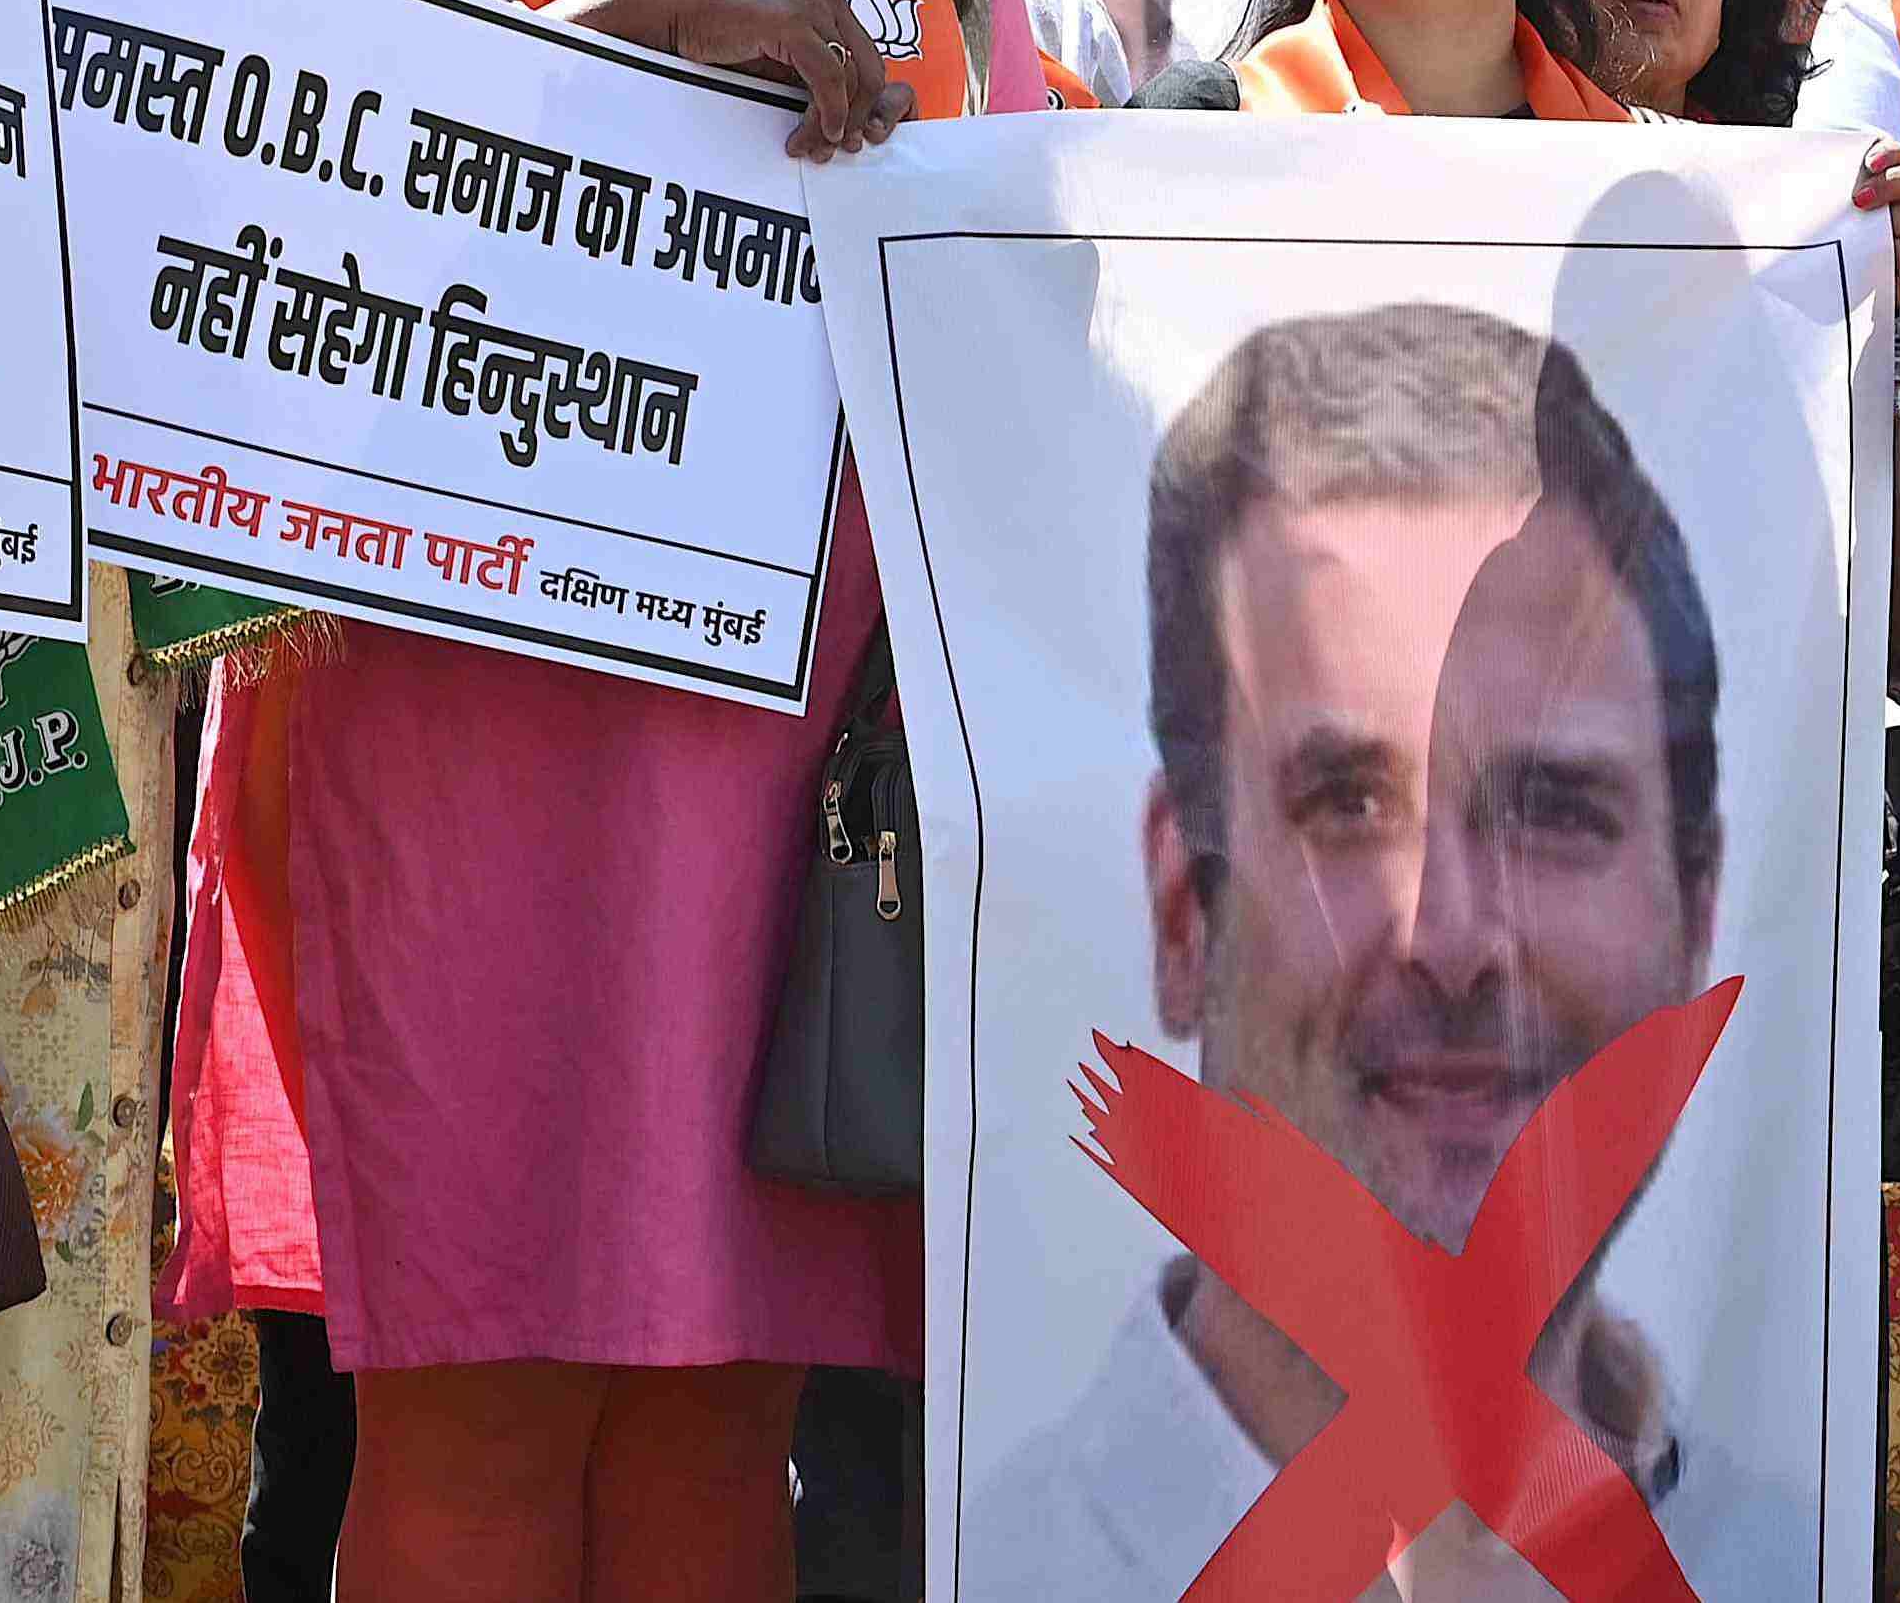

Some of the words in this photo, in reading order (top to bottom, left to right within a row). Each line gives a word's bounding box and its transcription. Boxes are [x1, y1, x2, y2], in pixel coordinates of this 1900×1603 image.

[223, 54, 384, 199] O.B.C.
[403, 108, 571, 249] समाज
[574, 160, 651, 266] का
[150, 224, 283, 362] नहीं
[268, 252, 422, 401] सहेगा
[420, 283, 699, 468] हिन्दुस्थान
[92, 453, 269, 537] भारतीय
[279, 499, 412, 570] जनता
[423, 527, 534, 596] पार्टी
[540, 568, 627, 614] दक्षिण
[635, 591, 696, 630] मध्य
[702, 597, 766, 647] मुंबई
